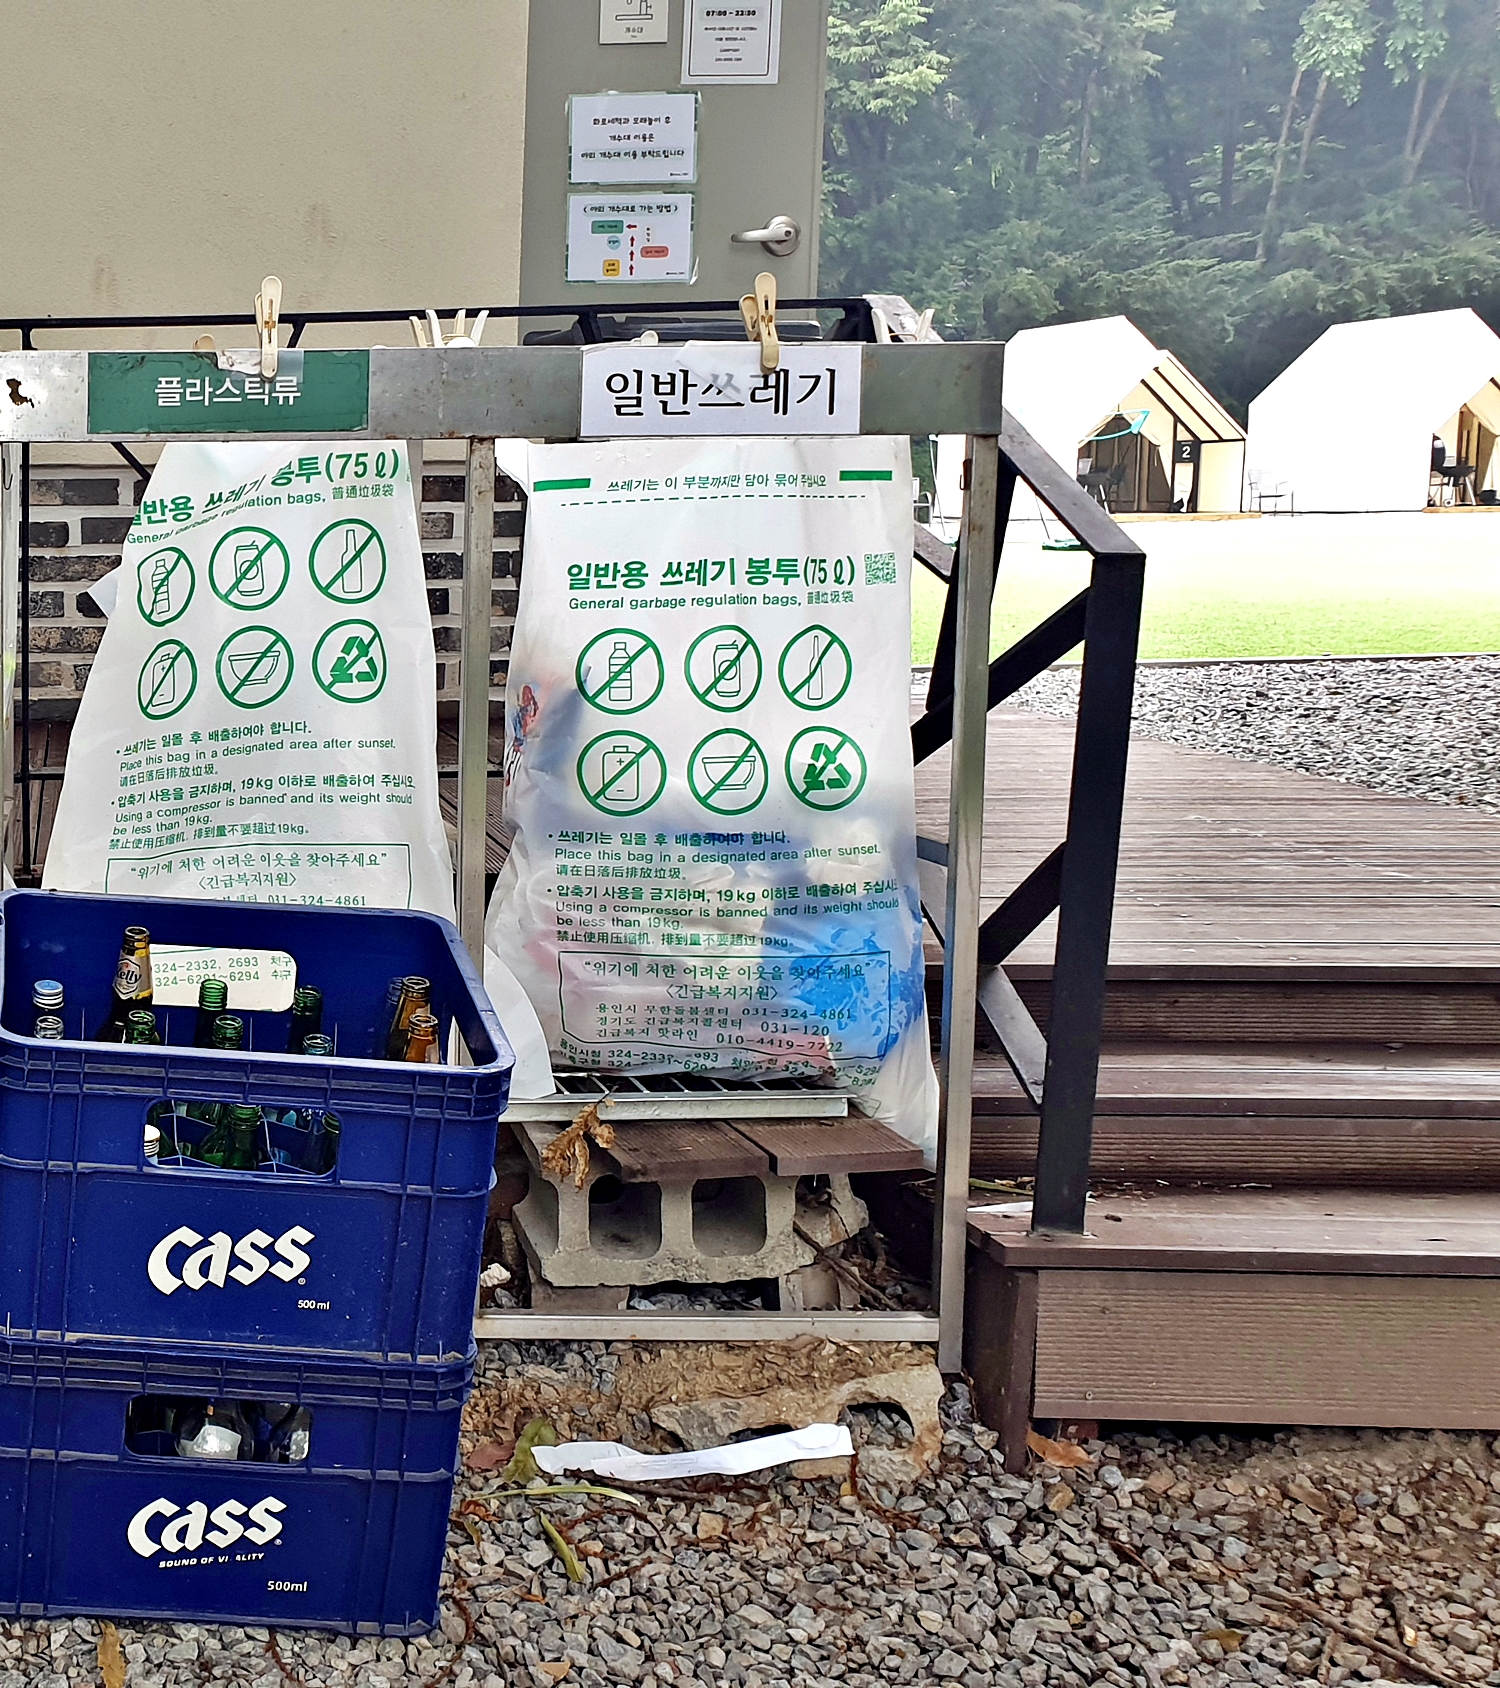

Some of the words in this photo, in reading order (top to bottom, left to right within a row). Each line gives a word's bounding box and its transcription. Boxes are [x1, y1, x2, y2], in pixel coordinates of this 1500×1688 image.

[154, 375, 302, 407] 플라스틱류
[605, 365, 838, 417] 일반쓰레기
[1181, 445, 1191, 459] 2
[607, 478, 660, 492] 쓰레기는
[665, 477, 678, 490] 이
[683, 474, 741, 490] 부분까지만
[745, 473, 769, 488] 담아
[774, 473, 798, 488] 묶어
[800, 474, 827, 488] 주십시오
[202, 474, 267, 514] 쓰레기
[127, 530, 174, 544] General
[221, 494, 282, 517] regulation
[287, 492, 326, 504] bags,
[566, 560, 649, 590] 일반용
[660, 558, 736, 586] 쓰레기
[569, 597, 624, 610] General
[629, 597, 686, 610] garbage
[691, 593, 758, 608] regulation
[762, 593, 802, 608] bags,
[123, 738, 157, 756] 쓰레기는
[161, 733, 184, 748] 일몰
[190, 731, 202, 744] 후
[208, 724, 264, 742] 배출하여야
[270, 721, 312, 736] 합니다.
[120, 759, 142, 772] Place
[146, 755, 163, 766] this
[167, 752, 190, 763] bag
[196, 750, 206, 760] in
[211, 750, 218, 758] a
[222, 739, 284, 757] designated
[290, 740, 318, 749] area
[323, 738, 352, 749] after
[358, 738, 396, 749] sunset.
[118, 792, 146, 808] 압축기
[148, 787, 184, 802] 사용을
[188, 780, 236, 798] 금지하며,
[278, 775, 316, 788] 이하로
[322, 774, 375, 788] 배출하여
[115, 810, 142, 823] Using
[146, 810, 152, 819] a
[157, 800, 222, 818] compressor
[226, 797, 235, 806] is
[240, 793, 285, 805] banned
[290, 793, 314, 803] and
[320, 793, 334, 803] its
[340, 793, 380, 805] weight
[386, 793, 412, 804] should
[113, 826, 127, 836] be
[132, 824, 152, 835] less
[156, 821, 180, 832] than
[557, 830, 613, 846] 쓰레기는
[620, 832, 648, 846] 일몰
[654, 833, 668, 846] 후
[674, 832, 744, 846] 배출하여야
[751, 831, 790, 844] 합니다.
[178, 857, 206, 872] 처한
[212, 852, 256, 870] 어려운
[260, 852, 302, 867] 이웃을
[554, 848, 592, 860] Place
[598, 850, 622, 861] this
[628, 850, 653, 864] bag
[660, 851, 672, 862] in
[677, 854, 686, 863] a
[692, 850, 766, 864] designated
[770, 850, 798, 861] area
[804, 847, 832, 859] after
[838, 844, 881, 856] sunset.
[556, 884, 598, 898] 압축기
[602, 886, 644, 900] 사용을
[650, 888, 710, 903] 금지하며,
[762, 887, 800, 900] 이하로
[806, 883, 857, 898] 배출하여
[556, 902, 593, 914] Using
[598, 904, 607, 912] a
[613, 905, 694, 916] compressor
[700, 907, 710, 917] is
[716, 906, 768, 918] banned
[774, 905, 798, 916] and
[804, 904, 818, 914] its
[823, 900, 862, 915] weight
[866, 898, 898, 911] should
[556, 916, 574, 926] be
[579, 916, 606, 927] less
[611, 916, 640, 928] than
[228, 956, 259, 968] 2693
[646, 963, 676, 978] 처한
[683, 966, 730, 980] 어려운
[737, 966, 784, 980] 이웃을
[596, 1002, 636, 1014] 용인시
[742, 1008, 852, 1020] 031-324-4861
[596, 1016, 636, 1026] 경기도
[760, 1021, 830, 1037] 031-120
[596, 1028, 650, 1038] 긴급복지
[716, 1033, 843, 1052] 010-4419-7722
[147, 1225, 316, 1295] Cass
[127, 1496, 288, 1558] Cass
[200, 1556, 214, 1564] OF
[218, 1552, 265, 1562] VIALITY
